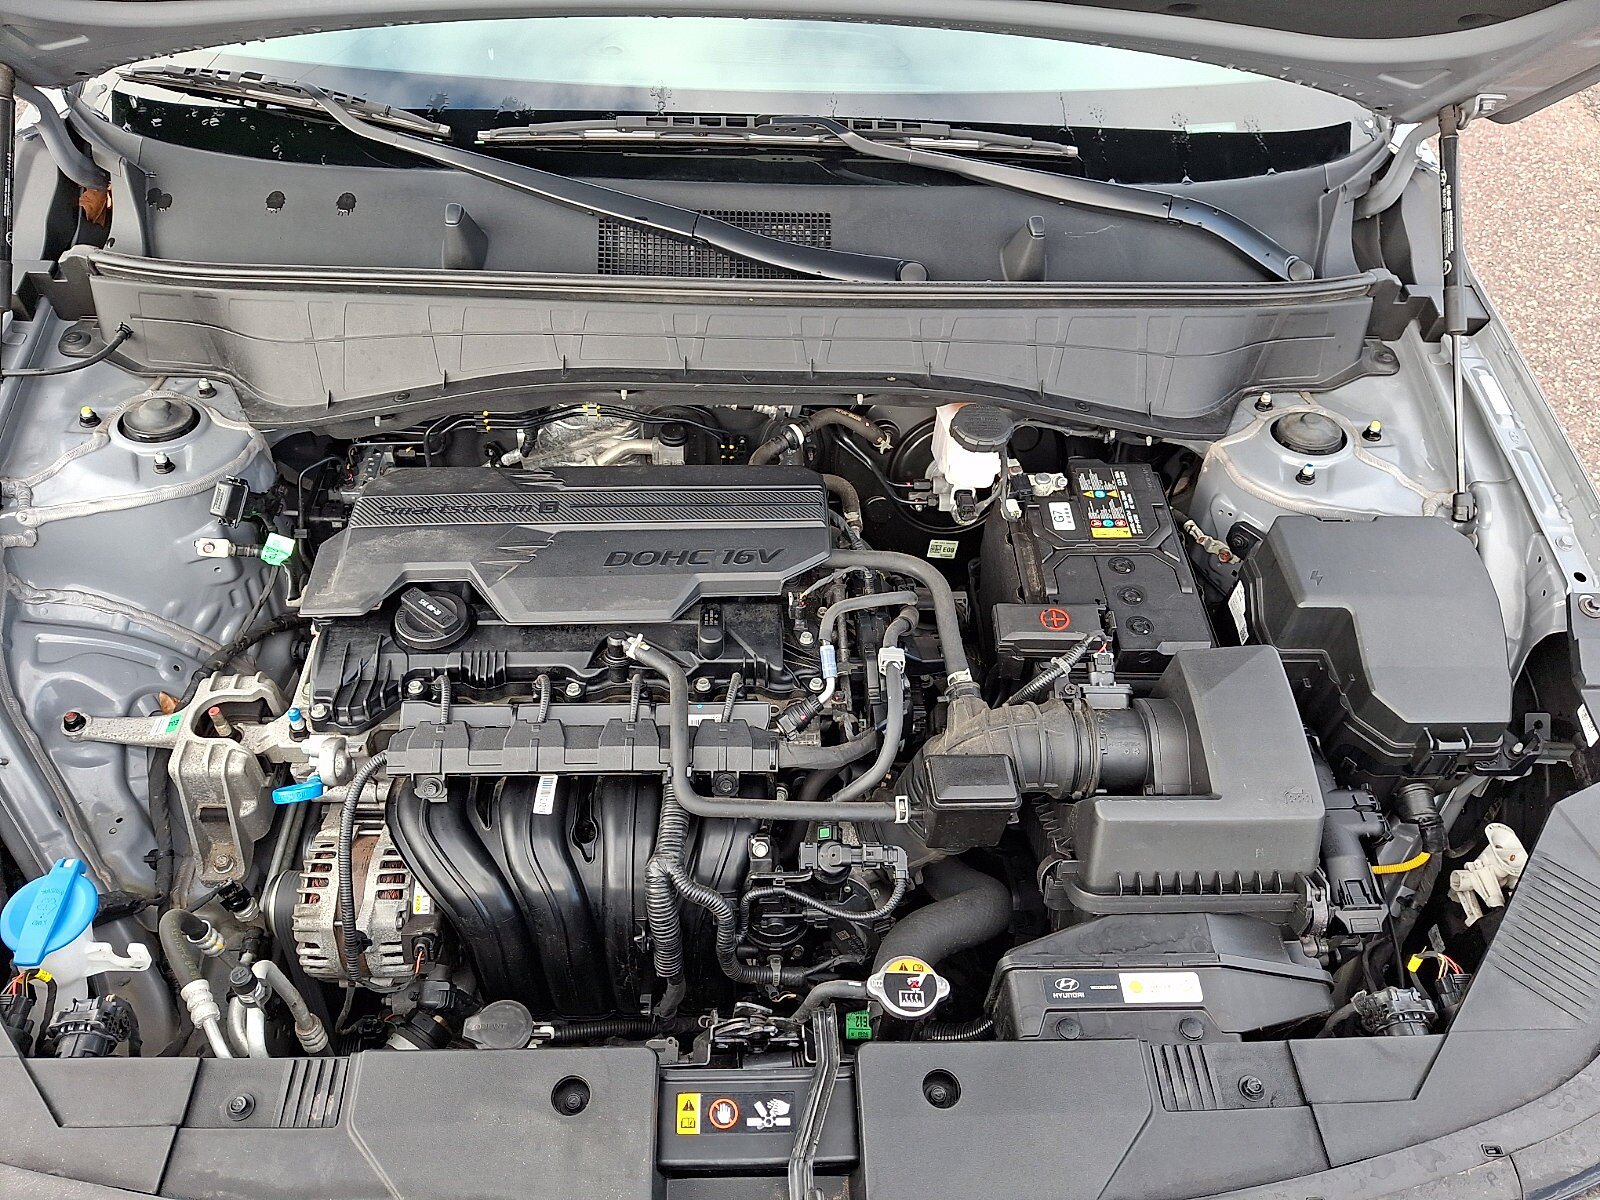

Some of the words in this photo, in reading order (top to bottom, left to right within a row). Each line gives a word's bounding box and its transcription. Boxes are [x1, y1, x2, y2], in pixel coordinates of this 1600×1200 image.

[376, 503, 533, 517] Smartstream
[603, 550, 715, 567] DOHC
[721, 548, 785, 565] 16V
[855, 1015, 868, 1028] E12
